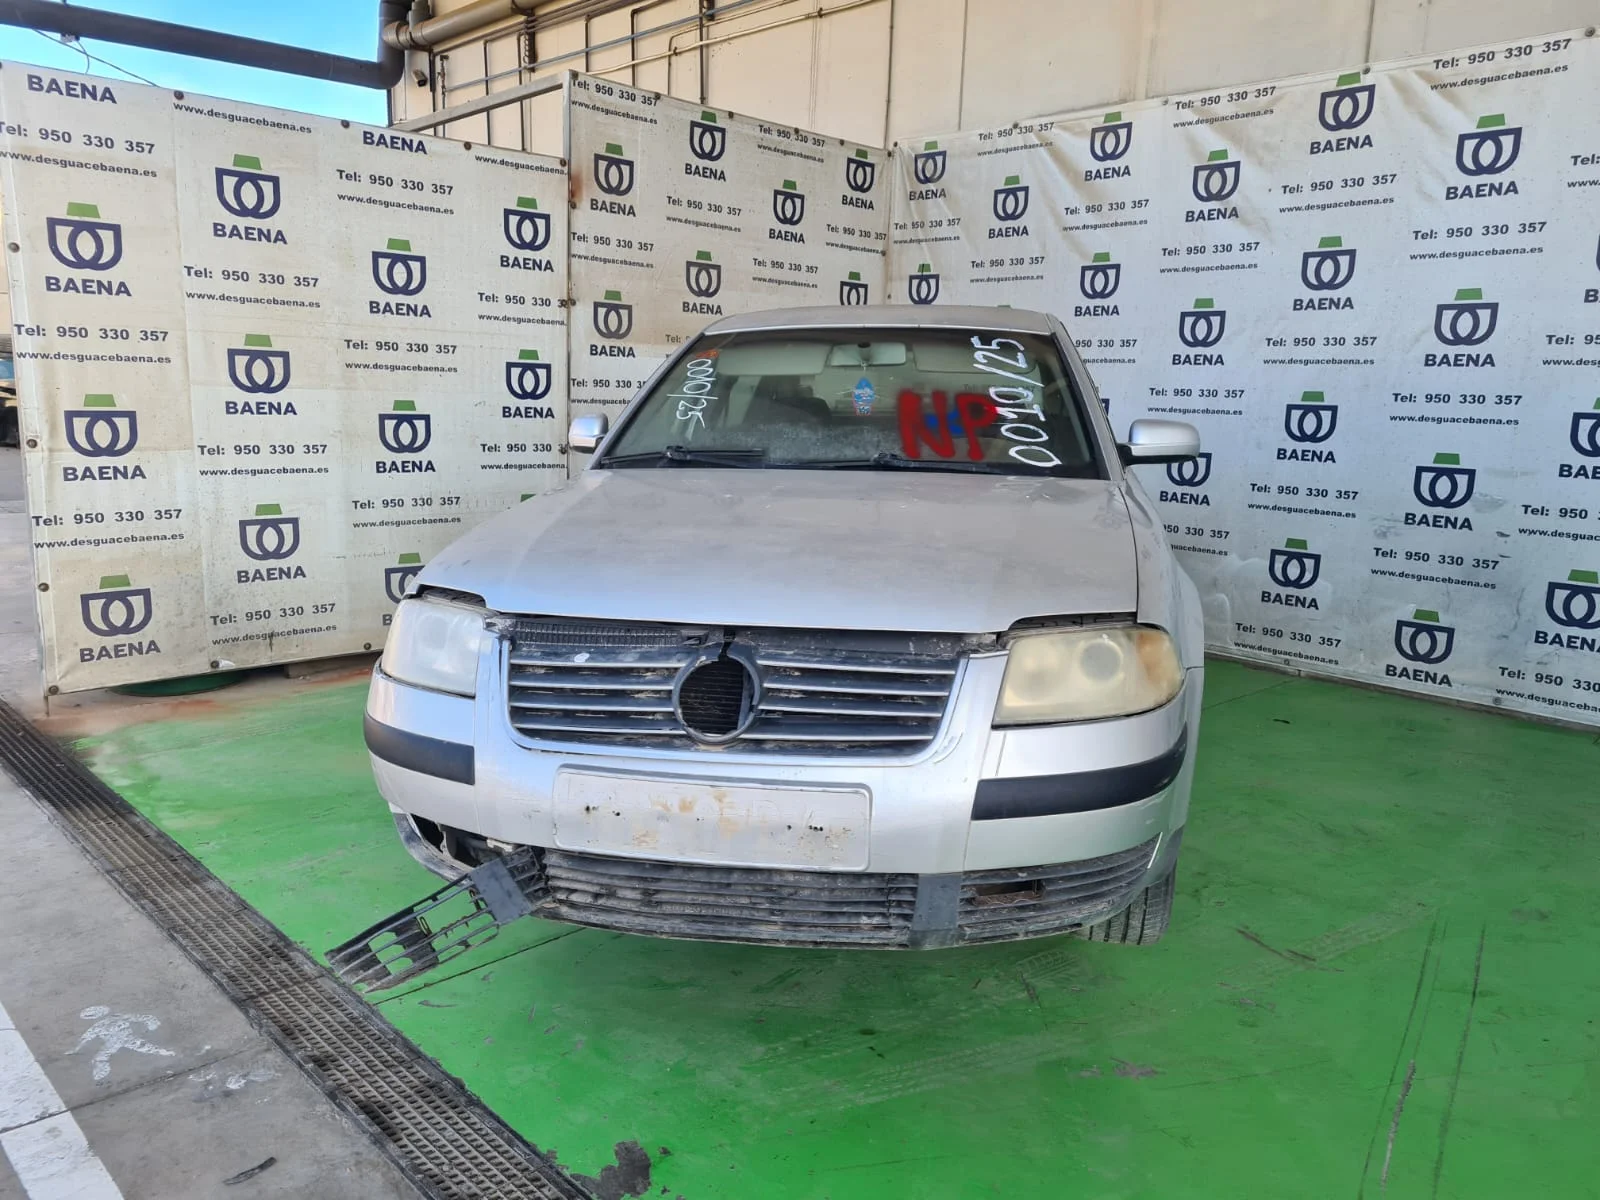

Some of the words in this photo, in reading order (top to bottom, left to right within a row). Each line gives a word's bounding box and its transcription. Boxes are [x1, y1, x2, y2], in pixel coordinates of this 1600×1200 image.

[1433, 57, 1460, 70] Tel:
[1468, 51, 1496, 64] 950
[1504, 45, 1534, 59] 330
[1542, 38, 1573, 53] 357
[1431, 65, 1569, 91] www.desguacebaena.es
[27, 74, 118, 104] BAENA
[572, 80, 590, 91] Tel:
[595, 83, 614, 96] 950
[619, 90, 637, 102] 330
[641, 95, 659, 106] 357
[1175, 100, 1195, 110] Tel:
[1201, 95, 1221, 107] 950
[1227, 91, 1249, 103] 330
[1254, 86, 1277, 98] 357
[173, 103, 312, 133] www.desguacebaena.es
[571, 100, 658, 125] www.desguacebaena.es
[1173, 109, 1274, 128] www.desguacebaena.es
[0, 121, 28, 137] Tel:
[39, 128, 72, 143] 950
[83, 134, 115, 149] 330
[125, 140, 155, 154] 357
[363, 130, 428, 155] BAENA
[1310, 134, 1374, 155] BAENA
[685, 163, 727, 182] BAENA
[1085, 165, 1131, 182] BAENA
[336, 169, 362, 183] Tel:
[369, 174, 394, 187] 950
[401, 179, 424, 192] 330
[432, 184, 454, 195] 357
[1281, 184, 1304, 195] Tel:
[1311, 180, 1334, 192] 950
[1341, 177, 1365, 188] 330
[1372, 174, 1397, 186] 357
[909, 188, 947, 201] BAENA
[1446, 181, 1519, 201] BAENA
[337, 194, 455, 215] www.desguacebaena.es
[590, 198, 637, 217] BAENA
[842, 194, 875, 211] BAENA
[1064, 206, 1081, 215] Tel:
[1085, 204, 1103, 214] 950
[1108, 202, 1126, 211] 330
[1131, 199, 1150, 209] 357
[1279, 198, 1395, 213] www.desguacebaena.es
[1185, 207, 1240, 223] BAENA
[213, 222, 288, 245] BAENA
[988, 225, 1029, 239] BAENA
[1063, 220, 1148, 232] www.desguacebaena.es
[1413, 229, 1438, 240] Tel:
[1447, 227, 1473, 238] 950
[1482, 224, 1510, 236] 330
[1518, 222, 1547, 234] 357
[572, 232, 589, 243] Tel:
[594, 235, 611, 246] 950
[616, 239, 633, 249] 330
[638, 242, 654, 252] 357
[769, 228, 806, 244] BAENA
[1162, 248, 1181, 256] Tel:
[1186, 245, 1207, 255] 950
[1212, 244, 1233, 254] 330
[1239, 242, 1261, 252] 357
[1410, 247, 1544, 260] www.desguacebaena.es
[500, 255, 555, 273] BAENA
[1160, 264, 1258, 273] www.desguacebaena.es
[184, 266, 213, 279] Tel:
[222, 270, 250, 282] 950
[259, 273, 285, 285] 330
[294, 276, 319, 288] 357
[45, 276, 132, 297] BAENA
[186, 292, 321, 308] www.desguacebaena.es
[683, 301, 723, 316] BAENA
[1293, 297, 1355, 311] BAENA
[369, 301, 432, 318] BAENA
[1074, 305, 1120, 317] BAENA
[14, 324, 47, 336] Tel:
[56, 326, 89, 338] 950
[99, 328, 130, 340] 330
[140, 330, 169, 342] 357
[1265, 338, 1287, 347] Tel:
[1294, 337, 1316, 347] 950
[1323, 337, 1346, 347] 330
[1353, 336, 1378, 346] 357
[344, 339, 369, 350] Tel:
[376, 341, 399, 352] 950
[406, 343, 429, 353] 330
[436, 344, 457, 355] 357
[590, 344, 636, 358] BAENA
[16, 351, 172, 363] www.desguacebaena.es
[1172, 354, 1225, 366] BAENA
[1263, 358, 1375, 366] www.desguacebaena.es
[1424, 354, 1496, 367] BAENA
[345, 362, 458, 373] www.desguacebaena.es
[1149, 388, 1168, 396] Tel:
[1173, 388, 1193, 397] 950
[1198, 389, 1219, 398] 330
[1224, 389, 1245, 399] 357
[1392, 393, 1417, 403] Tel:
[1425, 394, 1451, 404] 950
[1459, 394, 1486, 405] 330
[1494, 395, 1523, 406] 357
[225, 401, 298, 416] BAENA
[502, 406, 555, 419] BAENA
[897, 388, 999, 461] NP
[1390, 415, 1519, 426] www.desguacebaena.es
[197, 445, 225, 456] Tel:
[234, 445, 261, 455] 950
[269, 445, 295, 455] 330
[303, 444, 328, 454] 357
[1277, 448, 1337, 464] BAENA
[63, 465, 147, 482] BAENA
[199, 467, 329, 477] www.desguacebaena.es
[376, 460, 436, 474] BAENA
[1558, 464, 1600, 480] BAE
[1160, 491, 1211, 507] BAENA
[1250, 483, 1271, 493] Tel:
[1277, 485, 1299, 496] 950
[1306, 488, 1329, 498] 330
[1336, 490, 1359, 500] 357
[352, 500, 375, 510] Tel:
[382, 498, 405, 508] 950
[412, 497, 433, 507] 330
[440, 496, 461, 506] 357
[1248, 504, 1356, 518] www.desguacebaena.es
[32, 515, 64, 527] Tel:
[74, 512, 105, 525] 950
[115, 511, 145, 522] 330
[154, 509, 182, 520] 357
[353, 518, 461, 528] www.desguacebaena.es
[1404, 512, 1473, 531] BAENA
[34, 534, 185, 549] www.desguacebaena.es
[1373, 547, 1398, 559] Tel:
[1405, 551, 1430, 562] 950
[1438, 555, 1464, 566] 330
[1472, 559, 1500, 570] 357
[237, 566, 307, 584] BAENA
[1371, 569, 1496, 589] www.desguacebaena.es
[1261, 591, 1320, 610] BAENA
[210, 614, 237, 626] Tel:
[245, 610, 272, 621] 950
[280, 606, 305, 618] 330
[312, 603, 336, 614] 357
[212, 625, 337, 646] www.desguacebaena.es
[1236, 623, 1256, 634] Tel:
[1262, 627, 1284, 638] 950
[1290, 632, 1312, 643] 330
[1319, 637, 1342, 648] 357
[1534, 630, 1600, 653] BAEN
[80, 640, 161, 663] BAENA
[1385, 664, 1453, 688] BAENA
